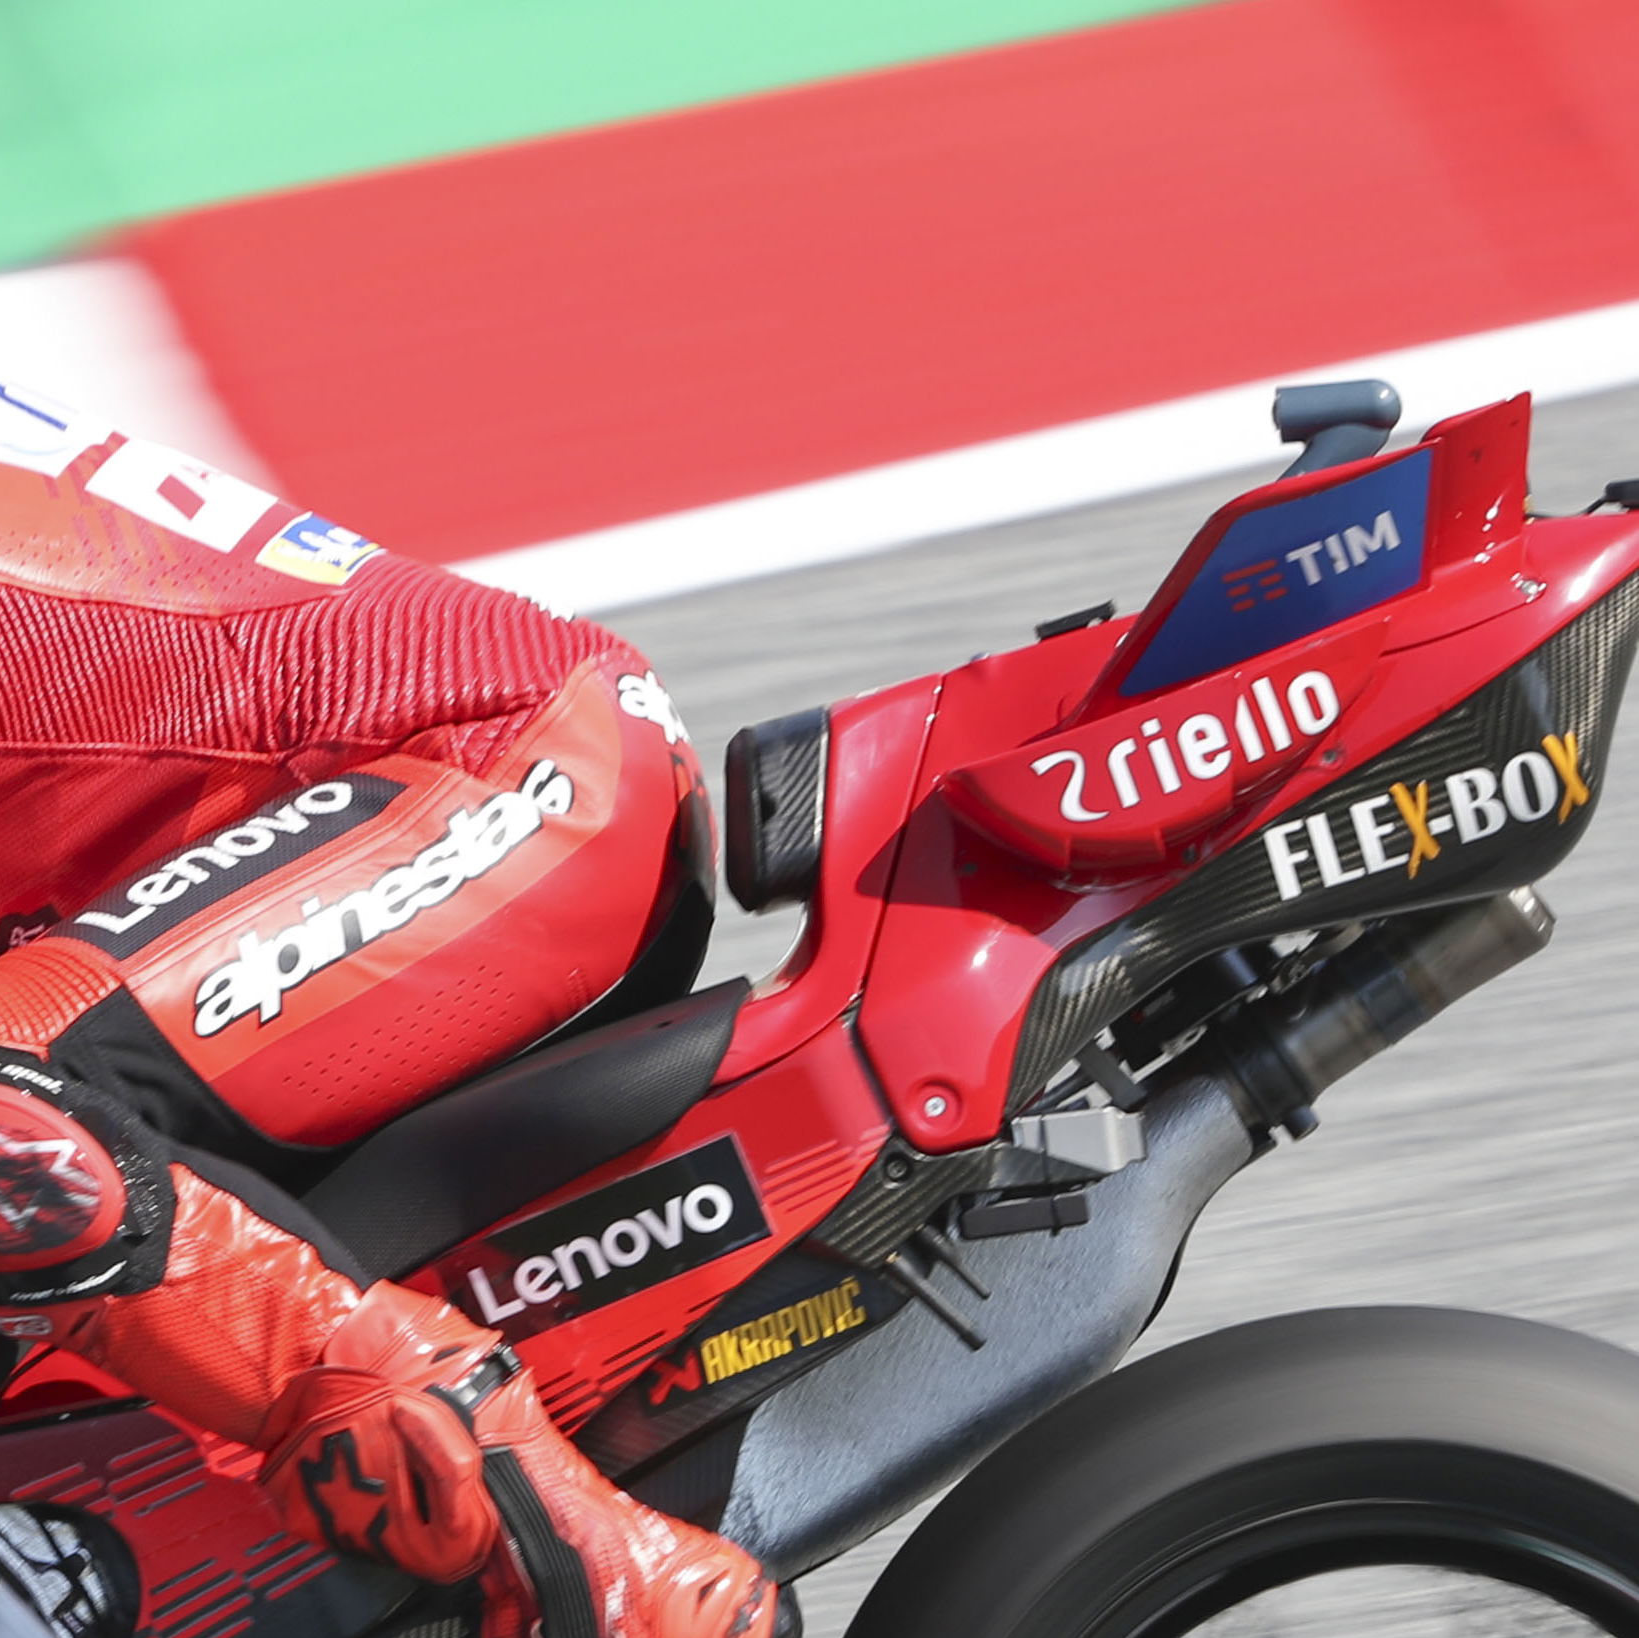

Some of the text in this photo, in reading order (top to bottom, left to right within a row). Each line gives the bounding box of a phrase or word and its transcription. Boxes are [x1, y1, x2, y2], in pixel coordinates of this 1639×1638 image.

[1286, 510, 1401, 587] TIM
[76, 779, 353, 936] Lenovo
[1263, 731, 1589, 900] FLEX-BOX
[193, 758, 574, 1038] alpinestars
[467, 1184, 733, 1325] Lenovo
